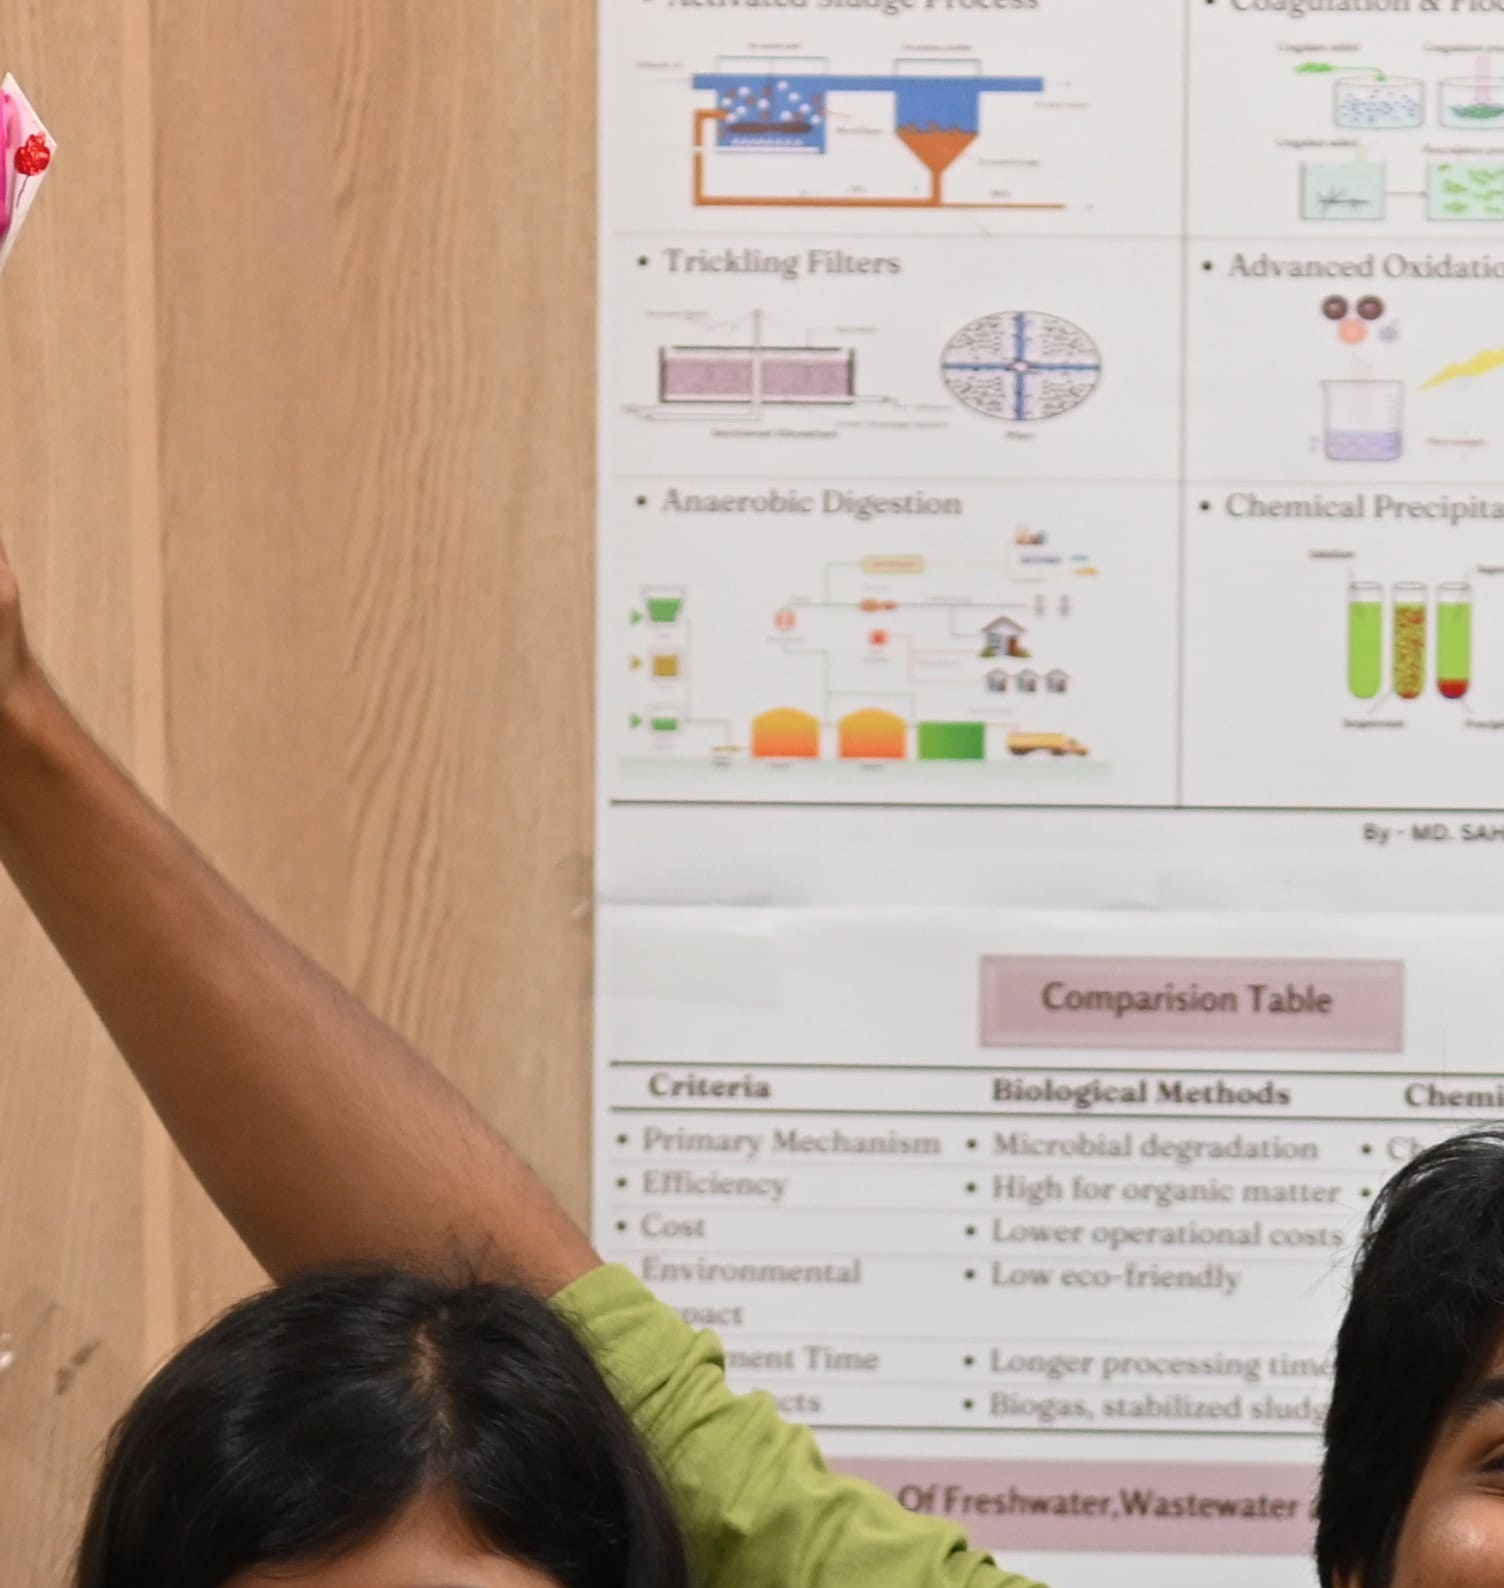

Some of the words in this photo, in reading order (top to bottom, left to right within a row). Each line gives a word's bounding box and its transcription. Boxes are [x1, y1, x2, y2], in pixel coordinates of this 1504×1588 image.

[663, 248, 803, 281] Trickling
[808, 249, 901, 275] Filters
[1227, 253, 1378, 280] Advanced
[661, 489, 816, 514] Anaerobic
[819, 490, 962, 521] Digestion
[1224, 493, 1368, 520] Chemical
[1362, 822, 1390, 846] By
[1042, 982, 1240, 1017] Comparision
[1243, 984, 1332, 1016] Table
[648, 1073, 771, 1101] Criteria
[991, 1078, 1150, 1111] Biological
[1155, 1080, 1292, 1107] Methods
[640, 1126, 767, 1162] Primary
[772, 1129, 941, 1155] Mechanism
[992, 1132, 1136, 1159] Microbial
[1141, 1134, 1318, 1166] degradation
[640, 1170, 785, 1202] Efficiency
[990, 1176, 1066, 1208] High
[1067, 1175, 1118, 1202] for
[1118, 1180, 1236, 1209] organic
[1240, 1184, 1341, 1205] matter
[639, 1212, 704, 1240] Cost
[990, 1218, 1087, 1245] Lower
[1094, 1222, 1262, 1252] operational
[1267, 1224, 1344, 1249] costs
[641, 1255, 860, 1285] Environmental
[989, 1261, 1056, 1288] Low
[1061, 1262, 1240, 1295] eco-friendly
[682, 1307, 743, 1334] pact
[727, 1349, 795, 1371] ment
[804, 1345, 880, 1372] Time
[988, 1349, 1097, 1383] Longer
[1102, 1352, 1262, 1384] processing
[780, 1392, 822, 1414] cts
[988, 1392, 1096, 1427] Biogas,
[1102, 1393, 1243, 1423] stabilized
[1250, 1395, 1328, 1427] sludg
[897, 1483, 937, 1513] Of
